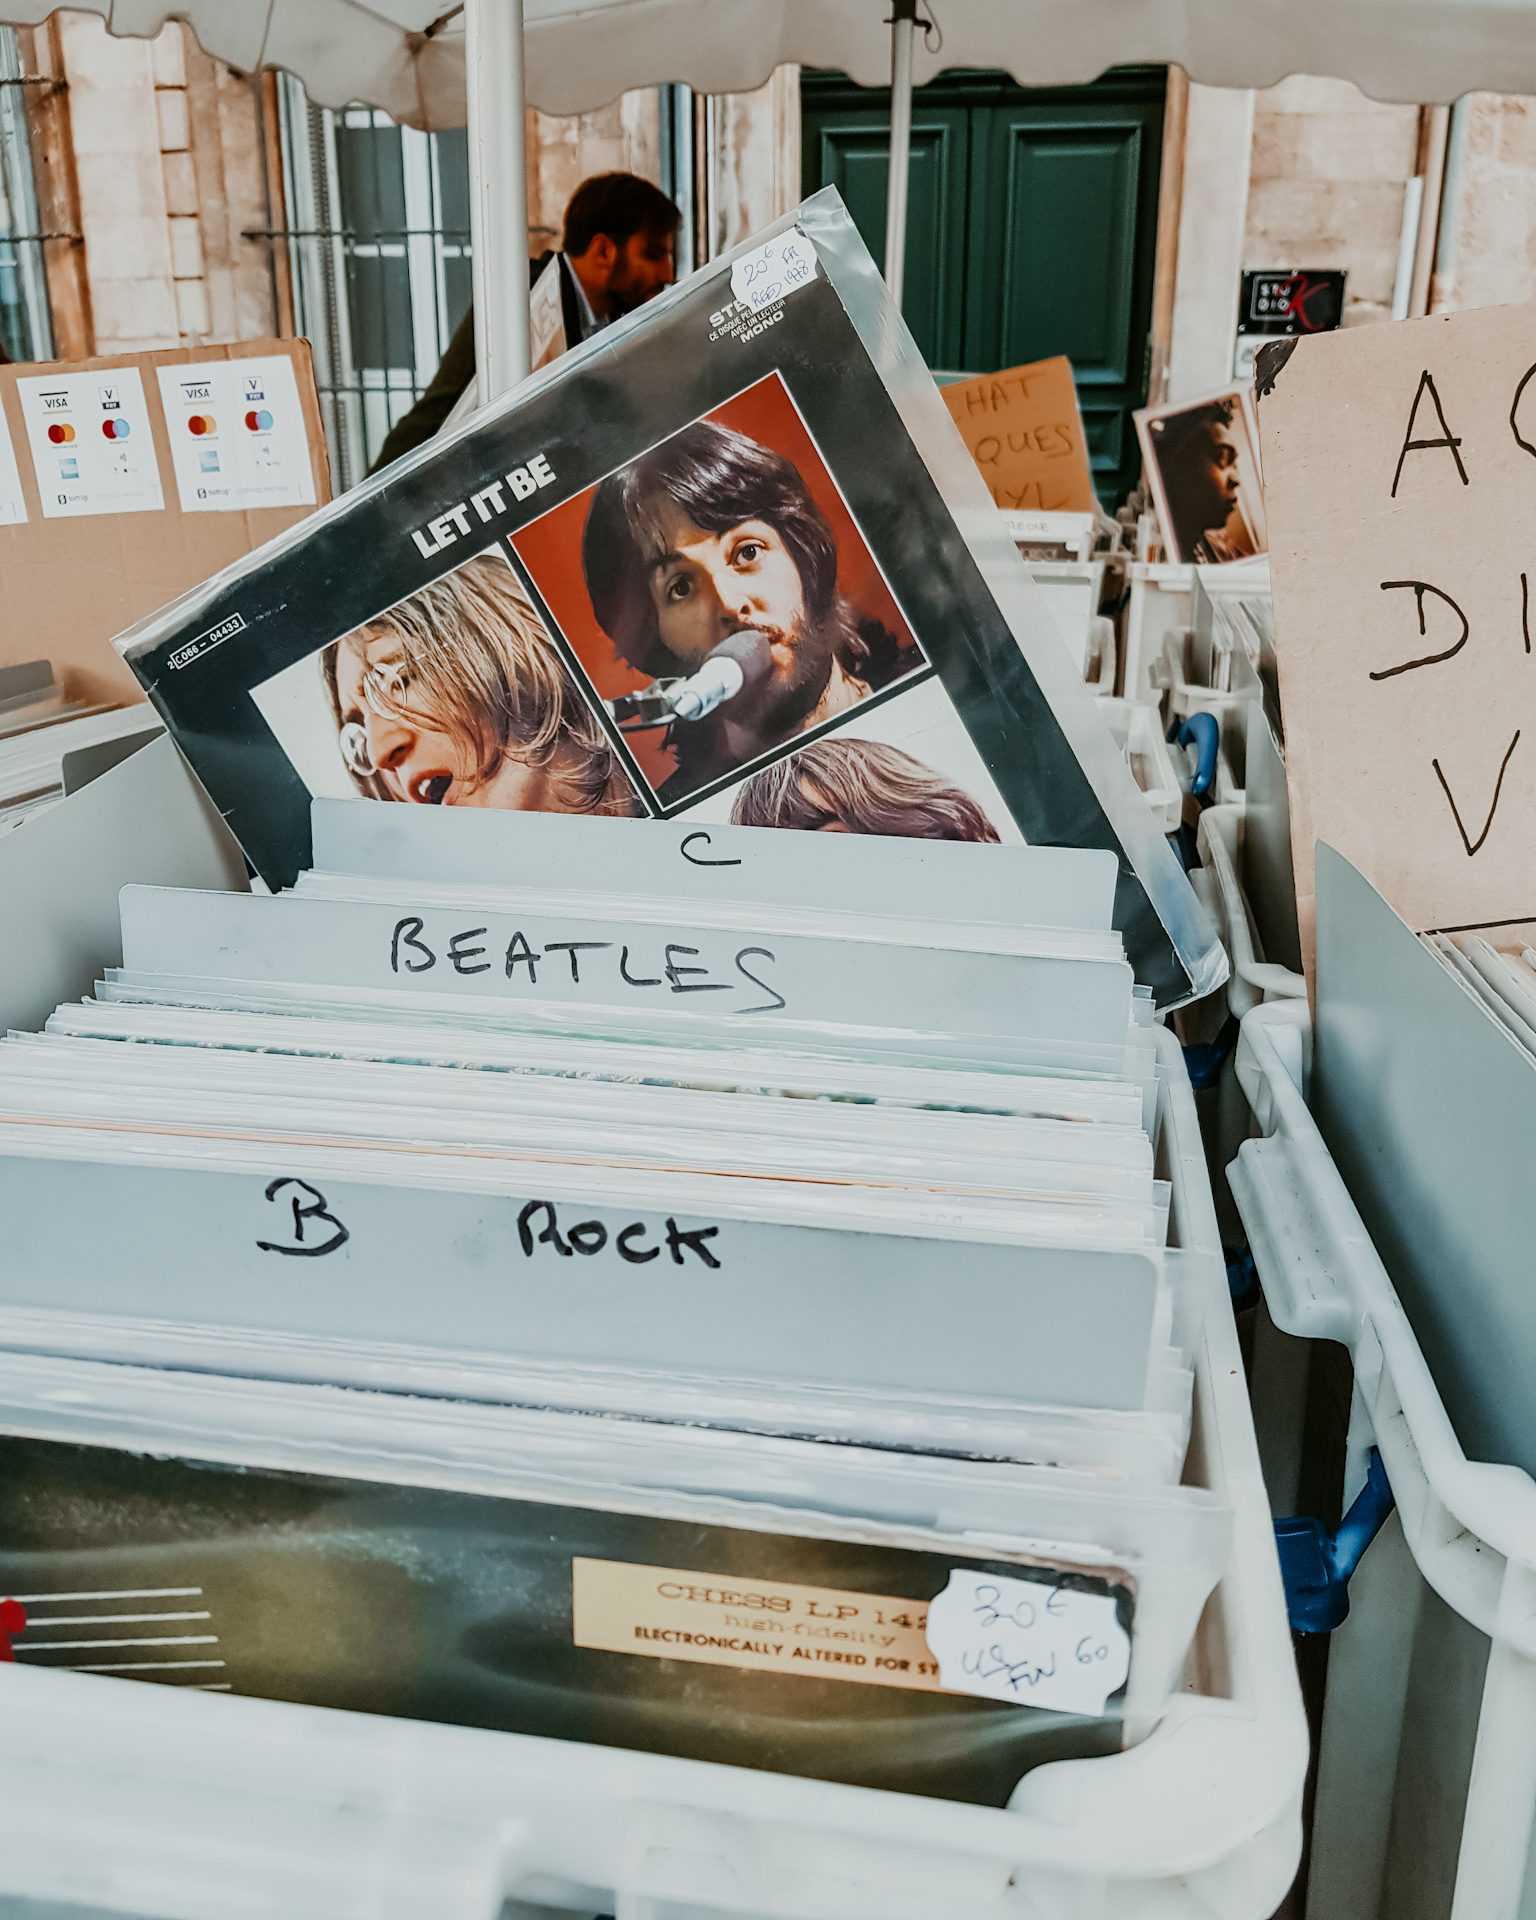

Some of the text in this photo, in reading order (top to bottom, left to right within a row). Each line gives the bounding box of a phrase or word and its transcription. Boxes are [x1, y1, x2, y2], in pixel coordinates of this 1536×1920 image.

[708, 330, 720, 342] CE
[718, 316, 742, 337] DISQUE
[730, 299, 786, 339] AVEC UN LECTEUR
[739, 310, 785, 344] MONO
[44, 398, 68, 409] VISA
[185, 388, 210, 399] VISA
[958, 372, 1046, 417] HAT
[410, 453, 557, 560] LET IT BE
[209, 619, 240, 642] 04433
[1432, 729, 1521, 857] V
[680, 831, 742, 866] C
[391, 916, 786, 1014] BEATLES
[255, 1177, 722, 1270] B ROCK
[656, 1582, 792, 1614] CHESS
[808, 1600, 860, 1621] LP
[633, 1625, 783, 1657] ELECTRONICALLY
[792, 1646, 867, 1667] ALTERED
[873, 1656, 910, 1672] FOR
[724, 1612, 898, 1648] high-fidelity
[1074, 1635, 1110, 1665] 60
